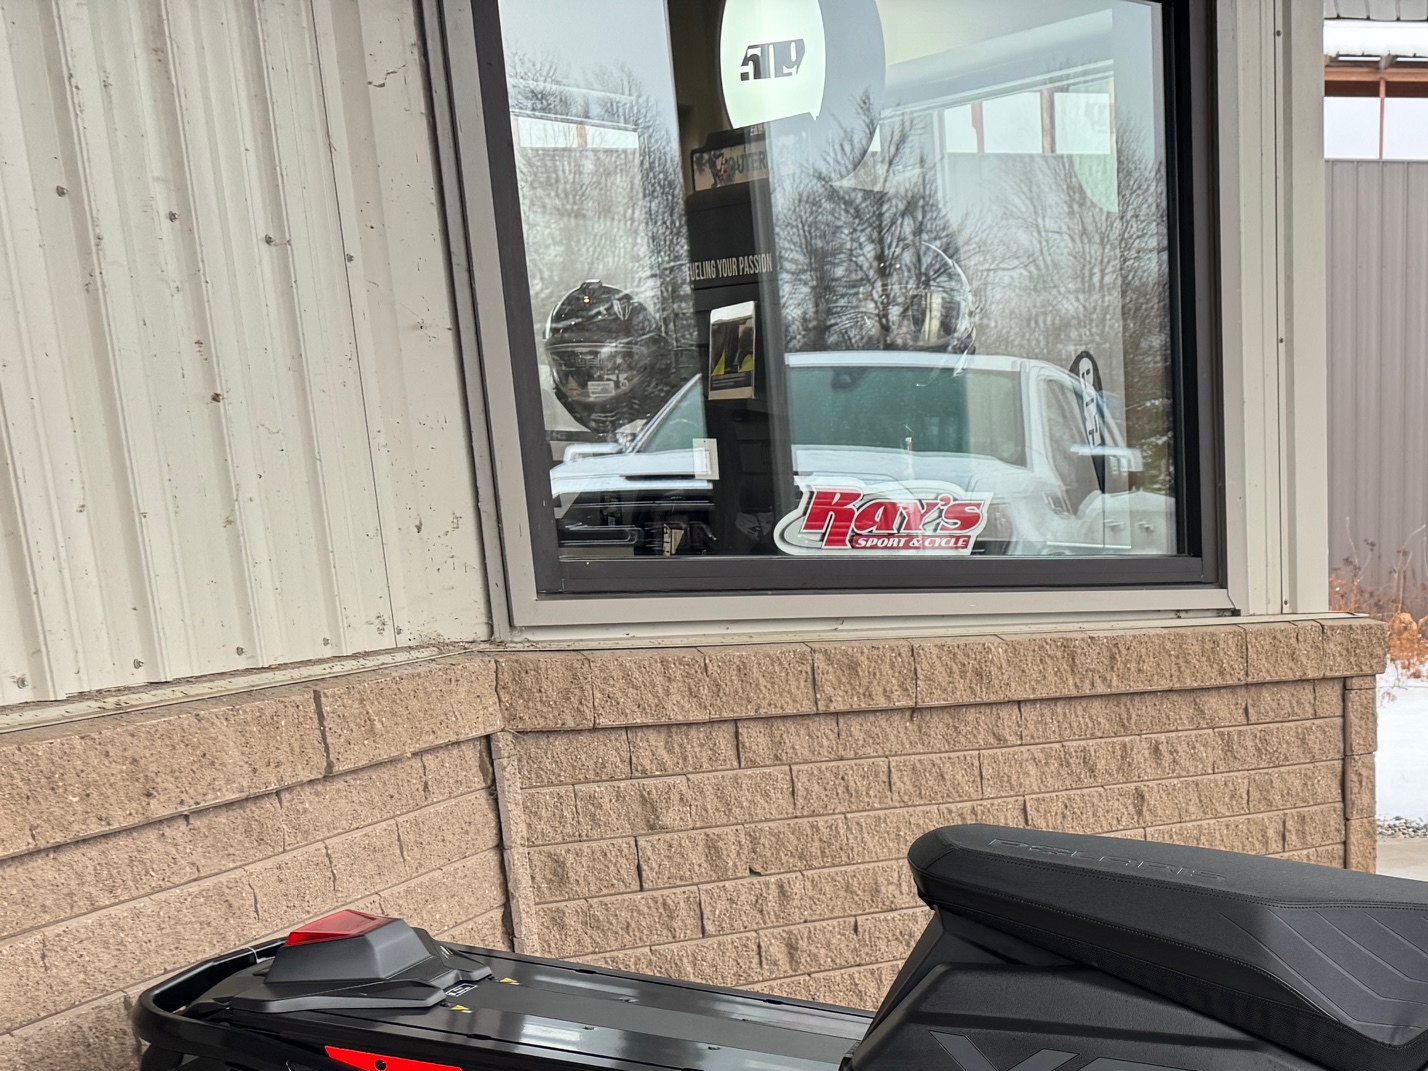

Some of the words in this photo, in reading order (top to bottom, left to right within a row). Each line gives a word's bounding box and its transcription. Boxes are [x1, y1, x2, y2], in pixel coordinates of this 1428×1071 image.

[688, 260, 716, 281] UELING
[717, 257, 738, 278] YOUR
[739, 253, 773, 275] PASSION
[855, 537, 909, 548] SPORT
[909, 537, 923, 548] &
[924, 537, 968, 548] CYCLE
